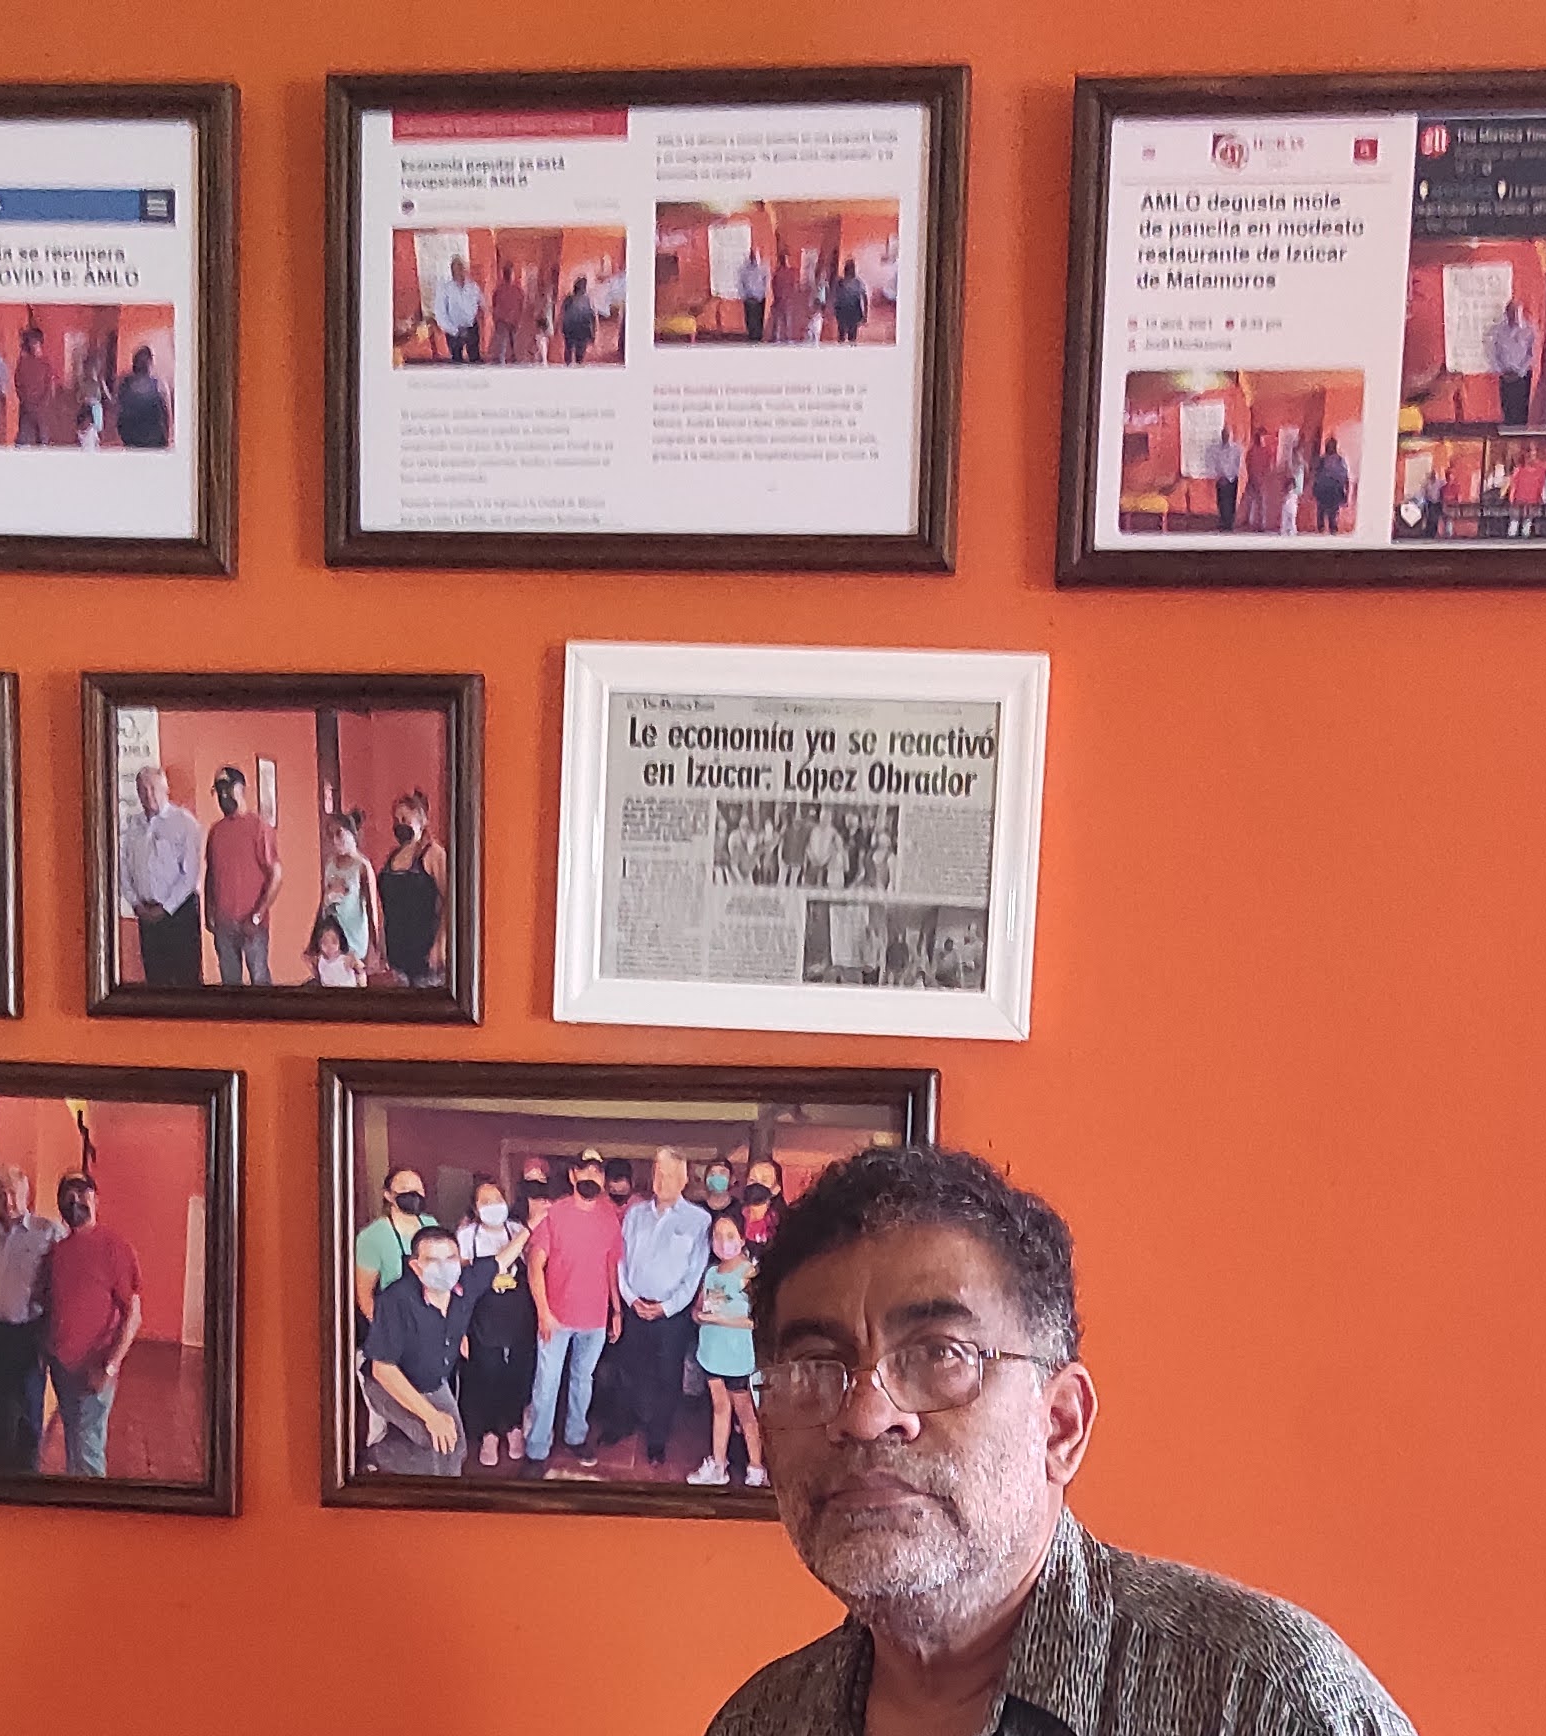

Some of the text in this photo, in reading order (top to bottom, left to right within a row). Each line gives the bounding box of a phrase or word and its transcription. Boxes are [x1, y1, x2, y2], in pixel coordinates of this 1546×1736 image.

[1140, 190, 1341, 216] AMLO degusta mole
[1139, 218, 1163, 238] de
[1247, 220, 1271, 236] en
[1277, 218, 1365, 237] modesto
[1137, 244, 1250, 265] restaurante
[1256, 244, 1280, 263] de
[1136, 269, 1277, 290] de Matamoros
[667, 720, 795, 753] economía
[805, 728, 836, 768] ya
[847, 729, 878, 756] se
[888, 725, 995, 760] reactivó
[643, 759, 675, 787] en
[783, 759, 858, 800] López
[868, 760, 979, 798] Obrador
